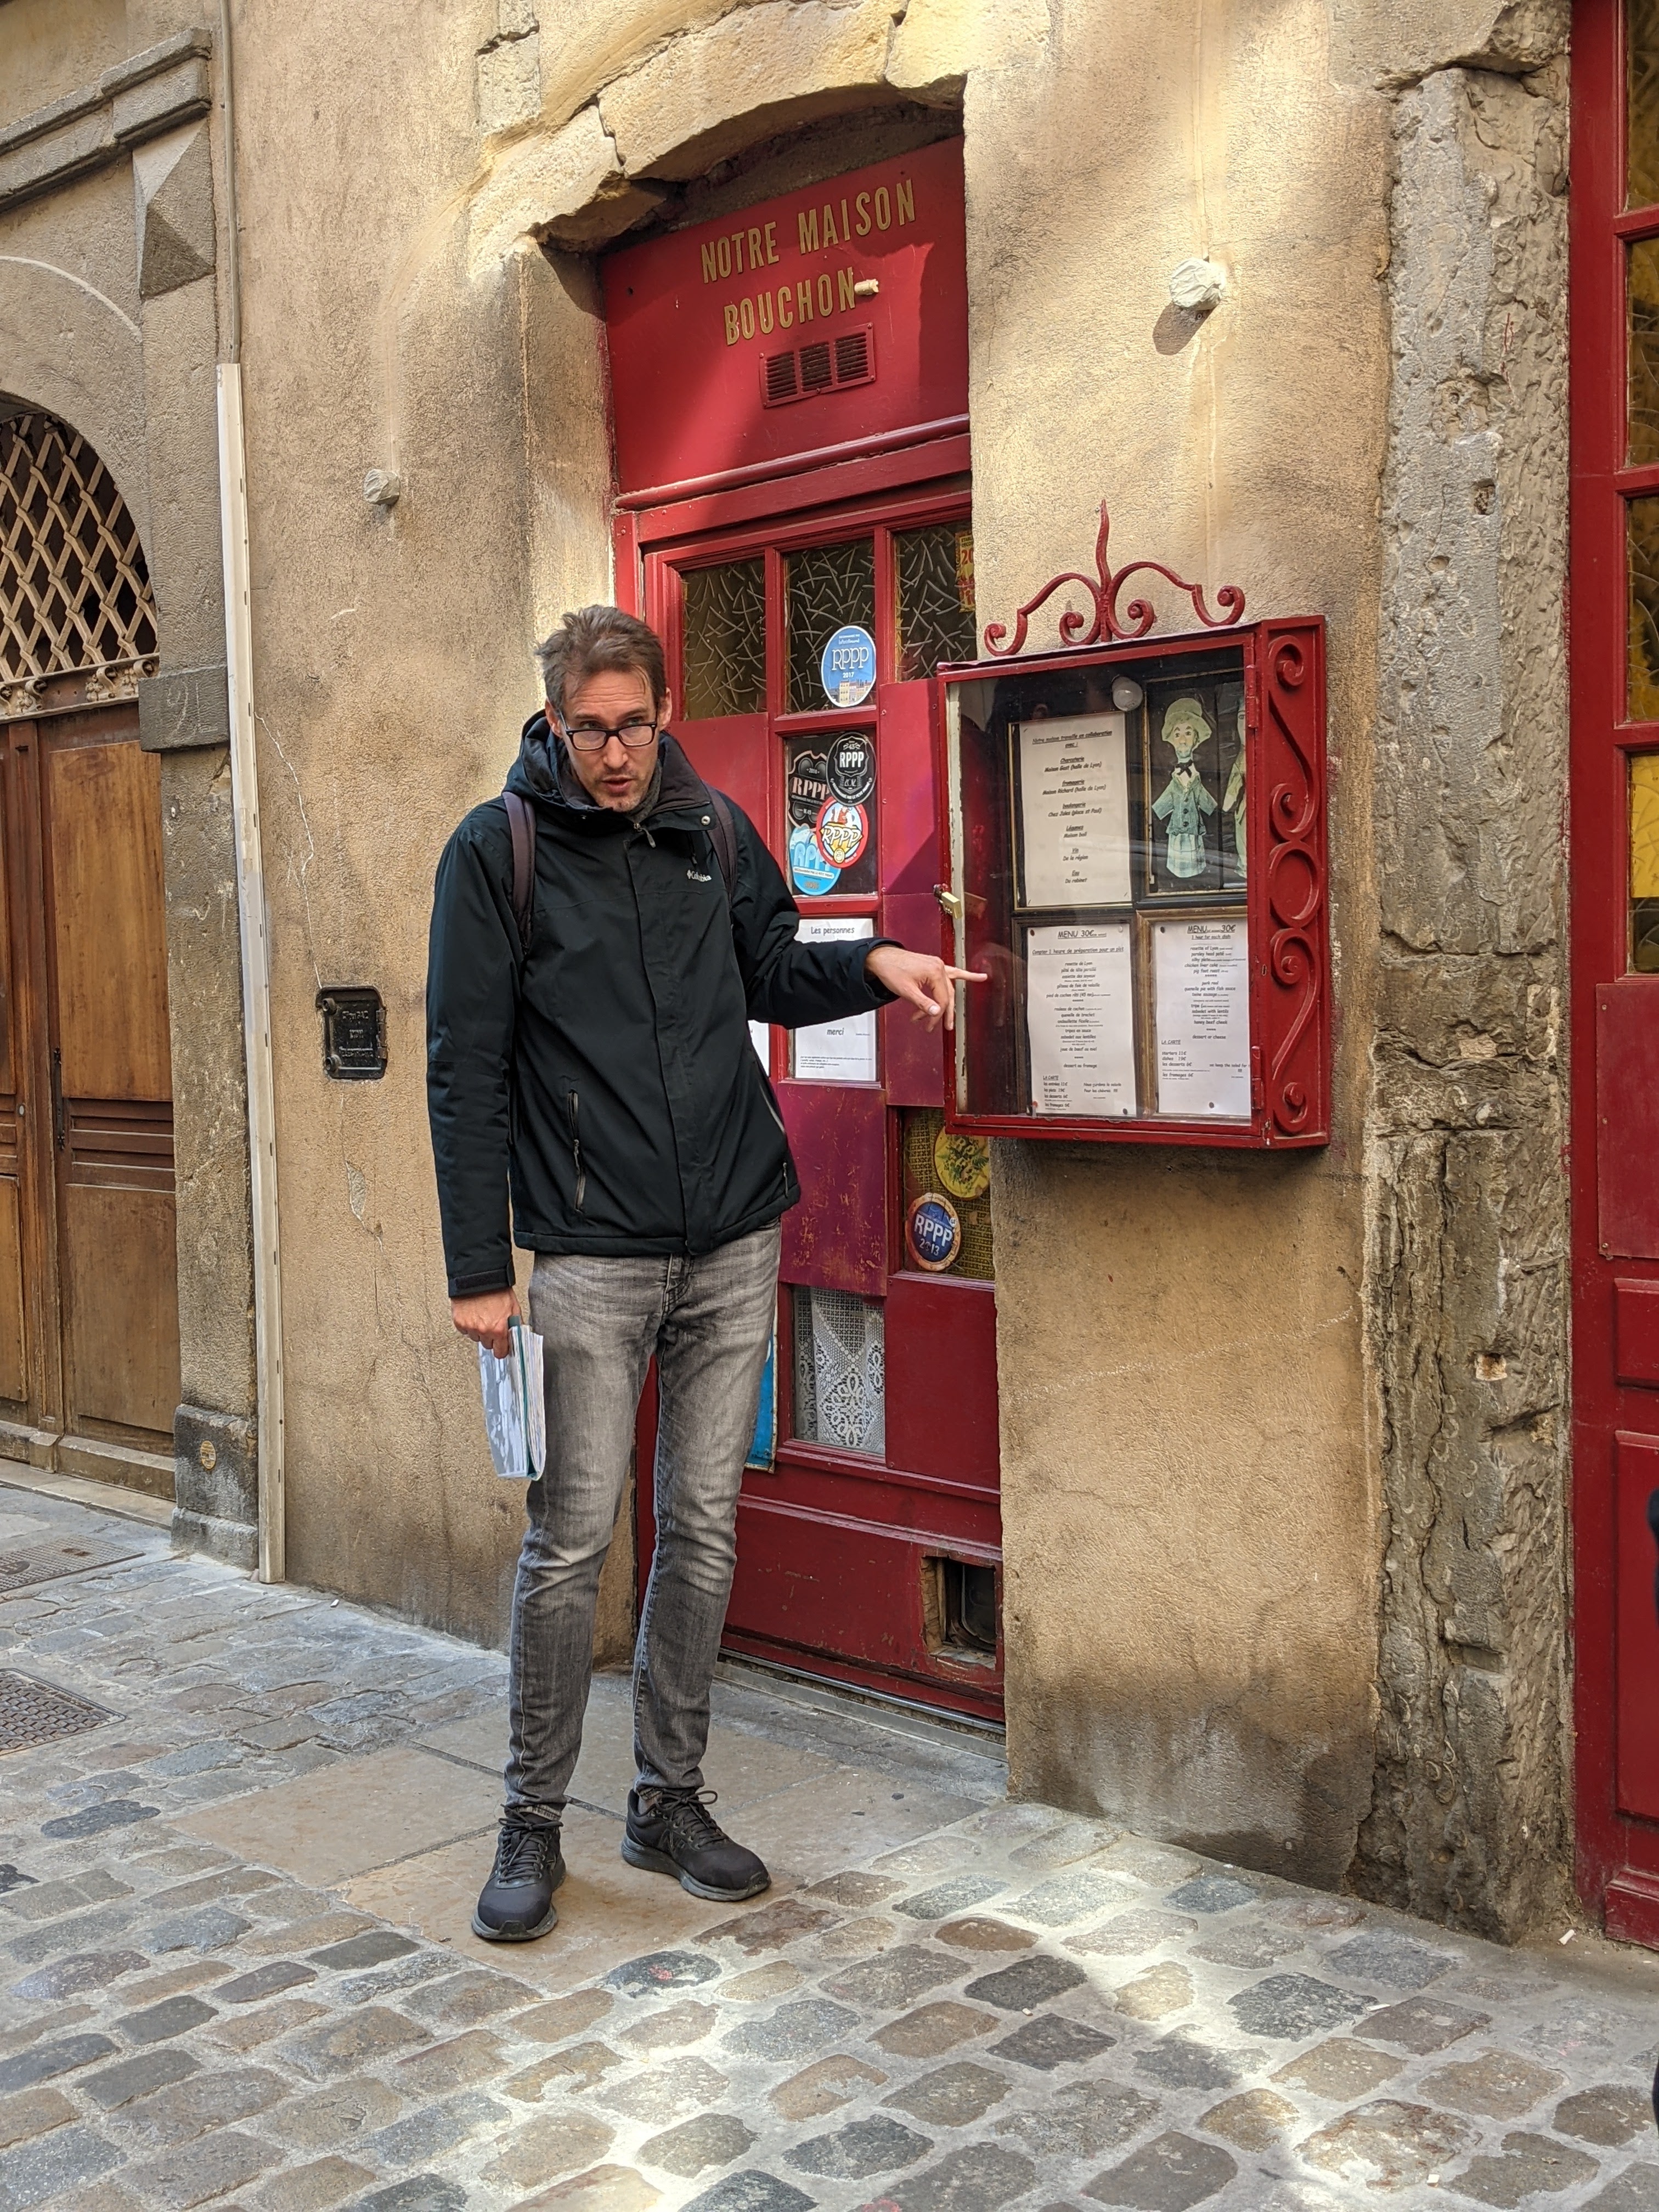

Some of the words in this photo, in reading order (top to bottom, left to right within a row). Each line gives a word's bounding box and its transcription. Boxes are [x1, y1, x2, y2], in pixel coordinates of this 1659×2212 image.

[701, 222, 779, 284] NOTRE
[798, 179, 916, 255] MAISON
[724, 267, 856, 346] BOUCHON
[832, 647, 869, 670] RPPP
[839, 752, 864, 768] RPPP
[822, 826, 861, 848] RPPP
[823, 927, 855, 935] personnes
[1058, 930, 1078, 939] MENU
[914, 1214, 953, 1247] RPPP
[919, 1238, 940, 1256] 2013
